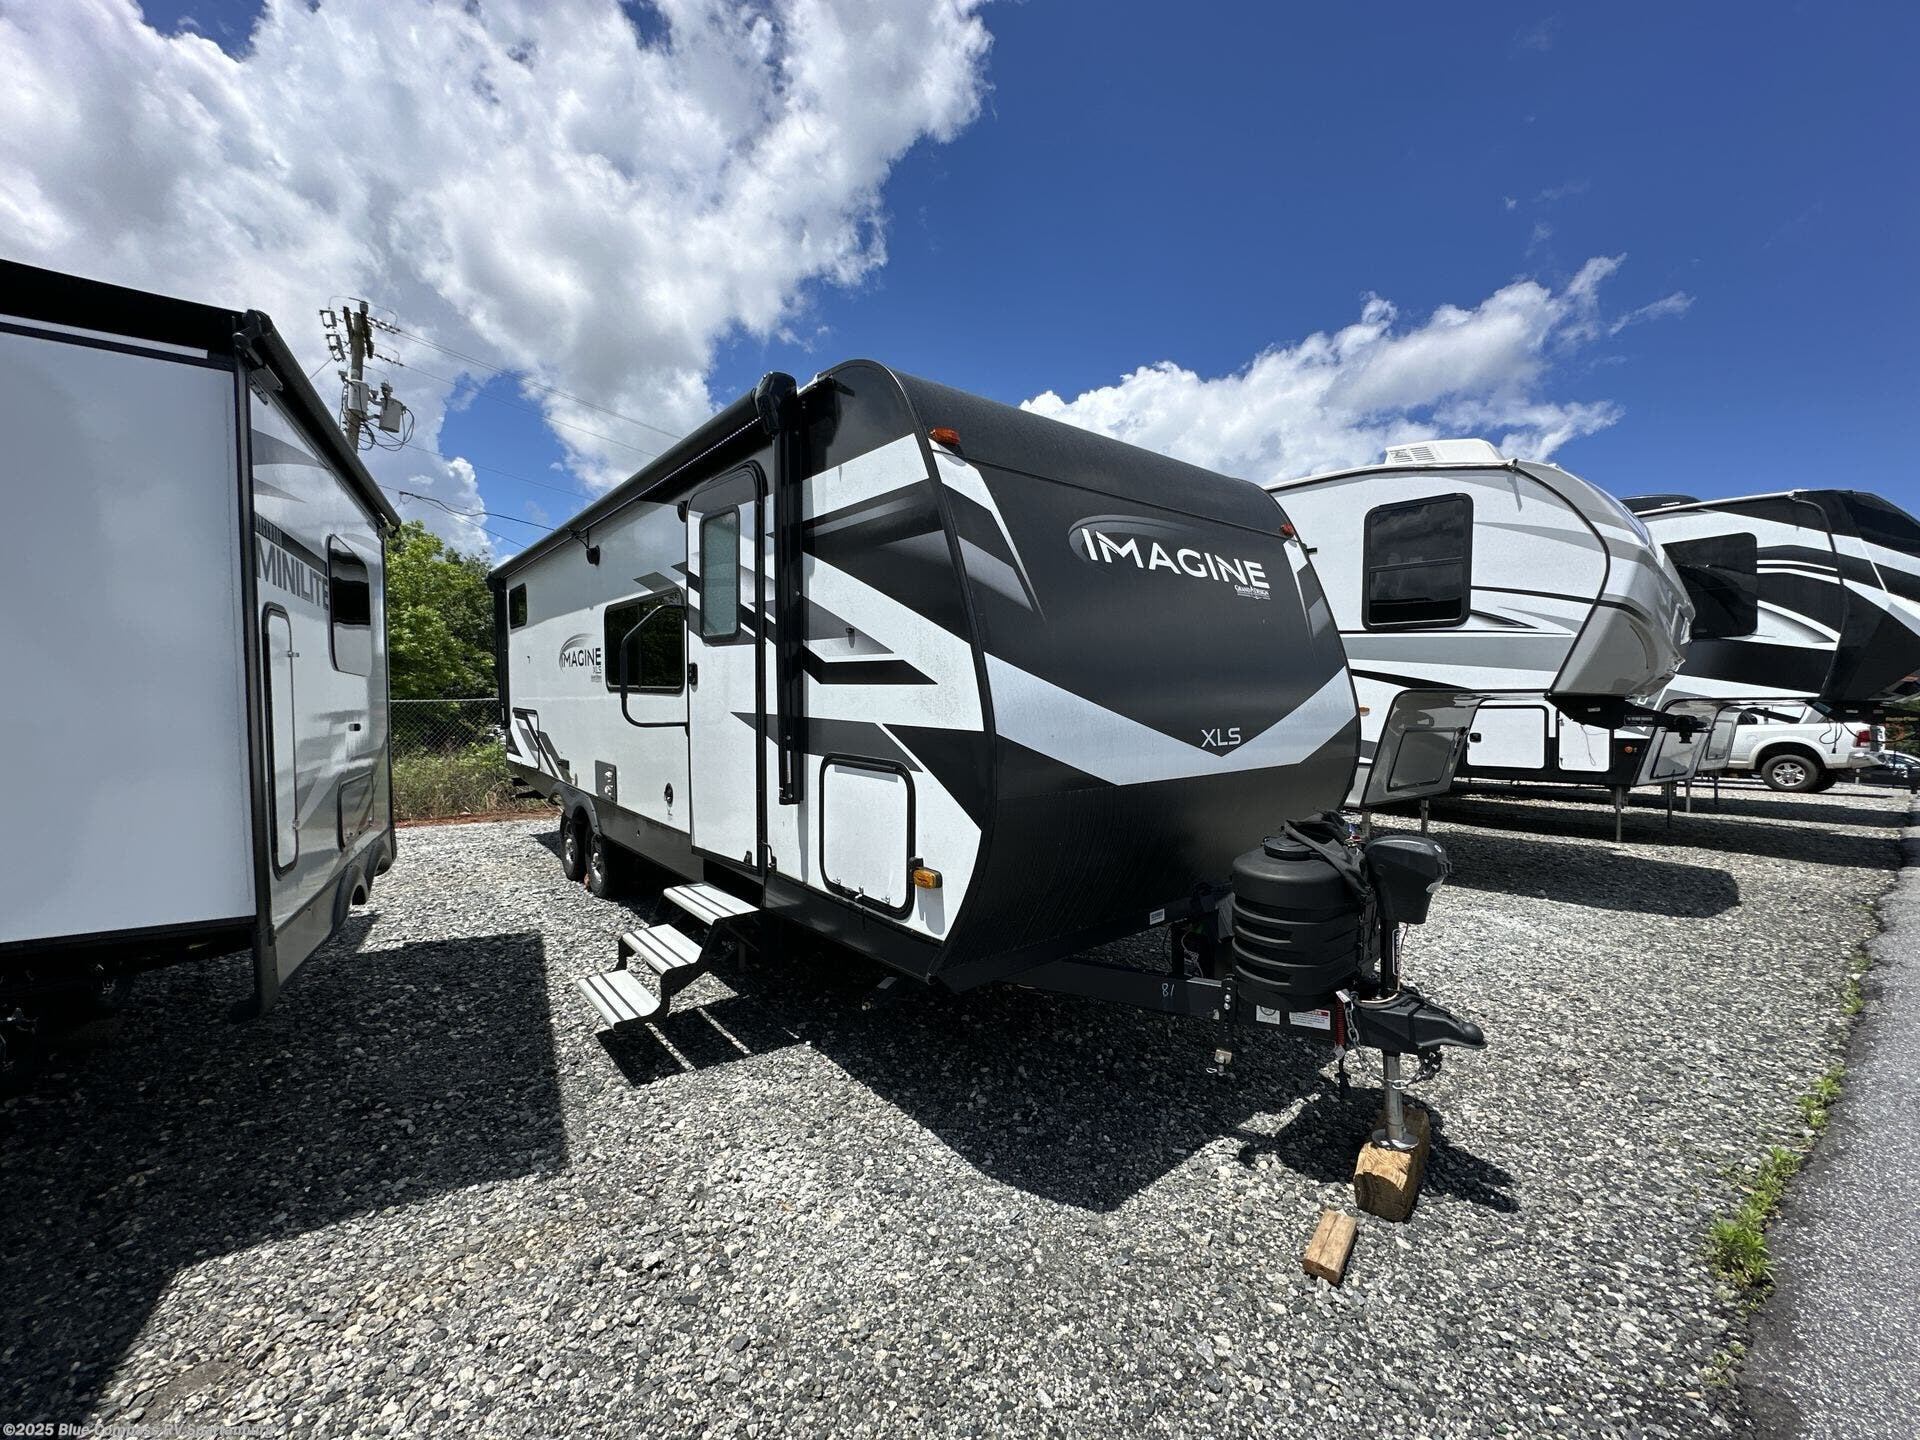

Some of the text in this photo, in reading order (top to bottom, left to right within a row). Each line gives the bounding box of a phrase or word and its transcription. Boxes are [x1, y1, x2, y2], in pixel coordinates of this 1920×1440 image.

[1081, 528, 1270, 589] IMAGINE
[560, 648, 602, 667] IMAGINE
[1201, 727, 1241, 747] XLS
